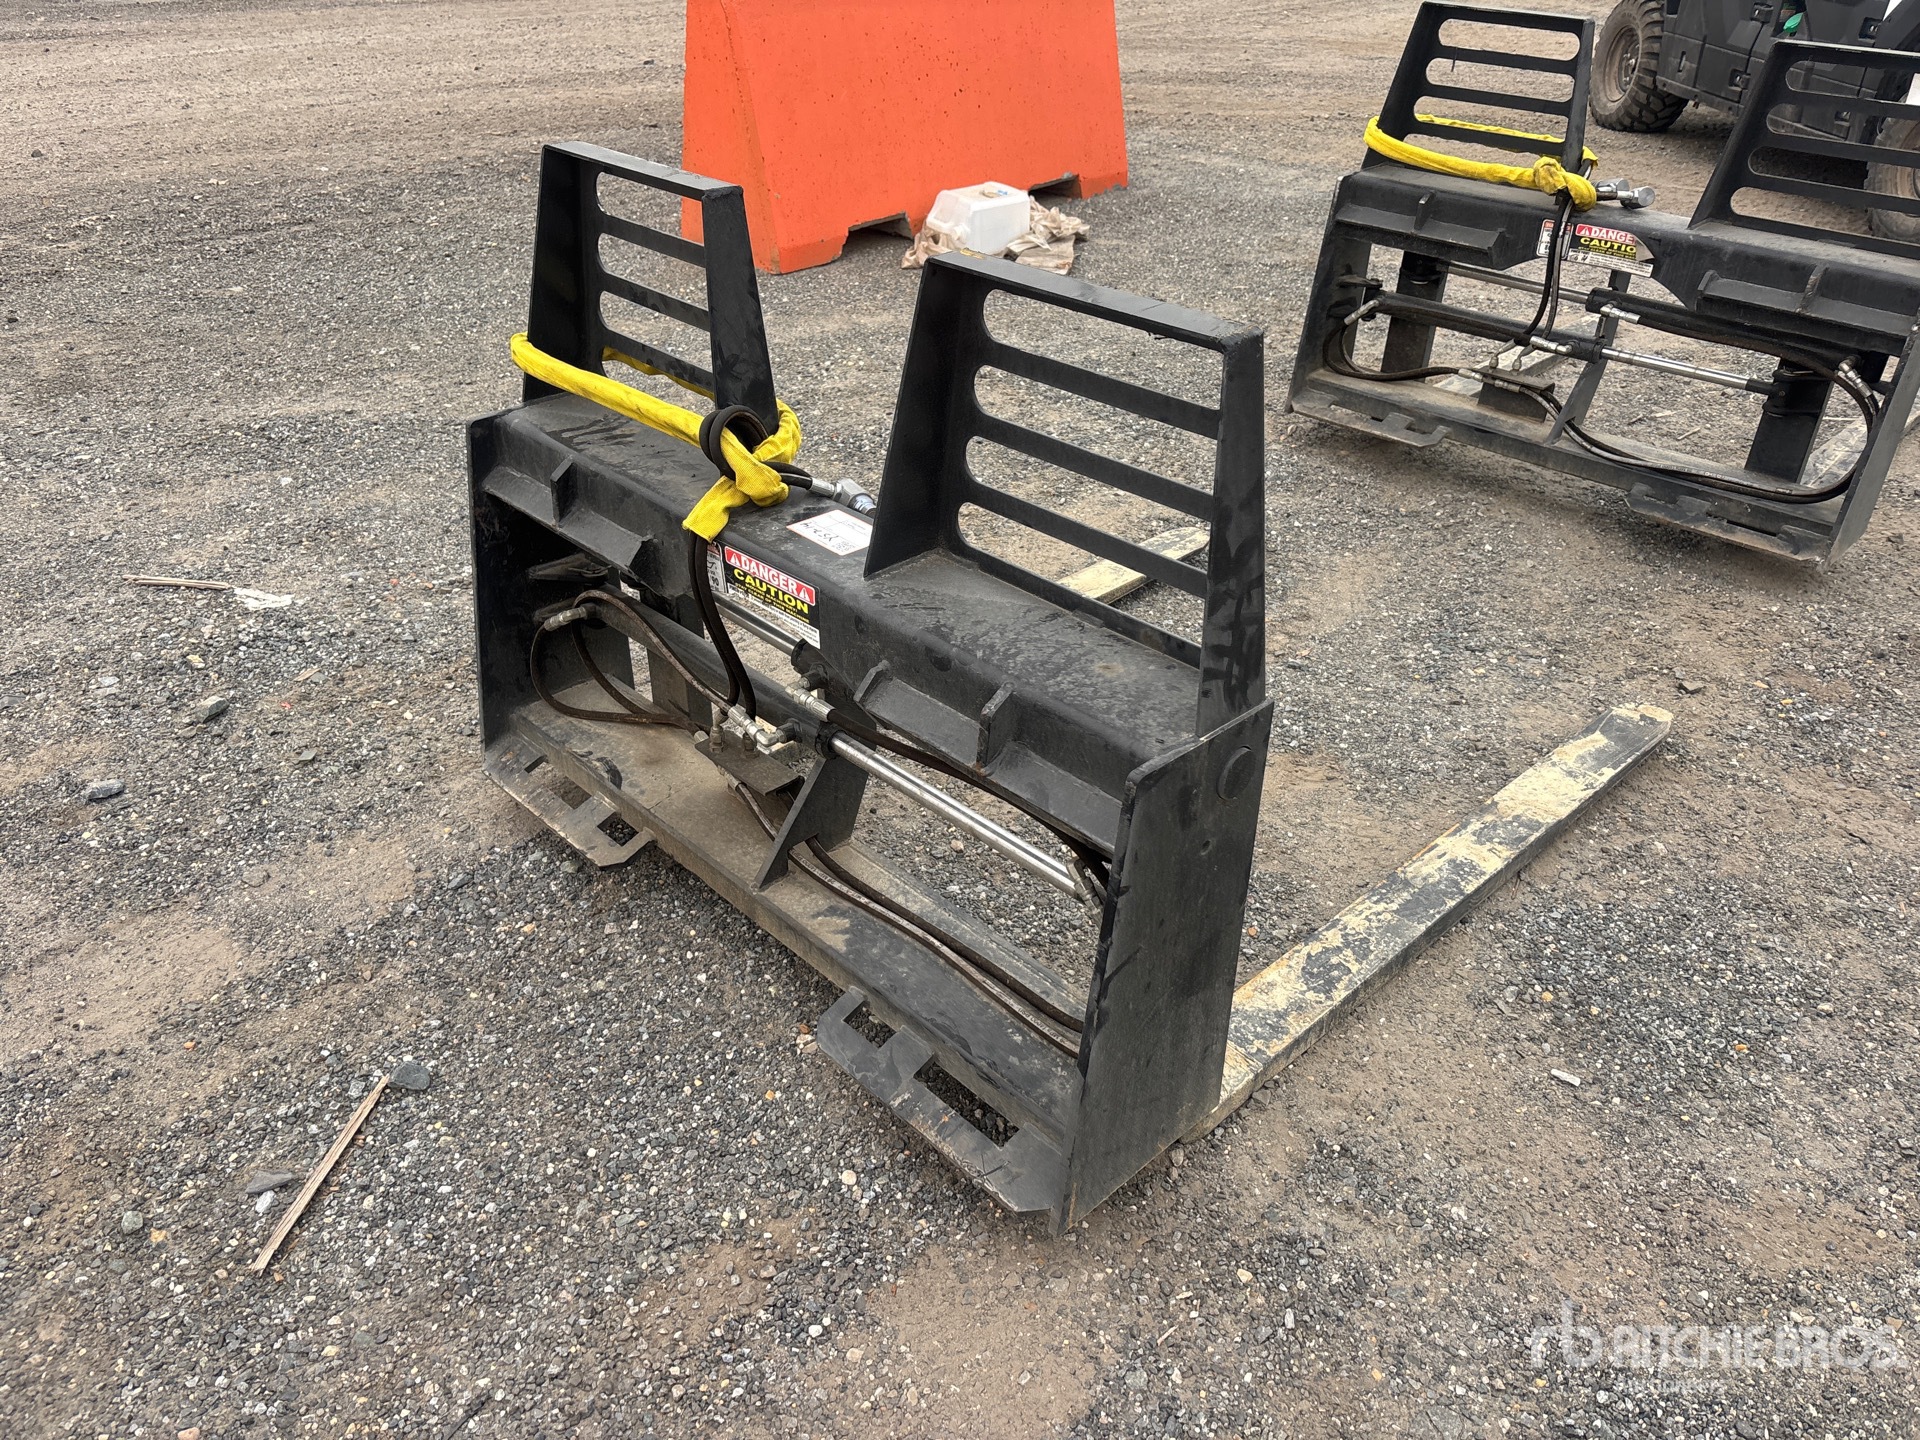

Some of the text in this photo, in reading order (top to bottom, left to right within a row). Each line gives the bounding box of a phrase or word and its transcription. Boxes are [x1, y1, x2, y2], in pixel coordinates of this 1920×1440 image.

[1581, 237, 1636, 253] CAUTIO
[1591, 228, 1635, 244] DANGE
[741, 555, 798, 596] DANGER
[734, 569, 809, 614] CAUTION
[745, 583, 765, 595] MOVING
[748, 589, 764, 600] CLEAR
[773, 601, 785, 610] THIS
[785, 608, 810, 624] MACHINE
